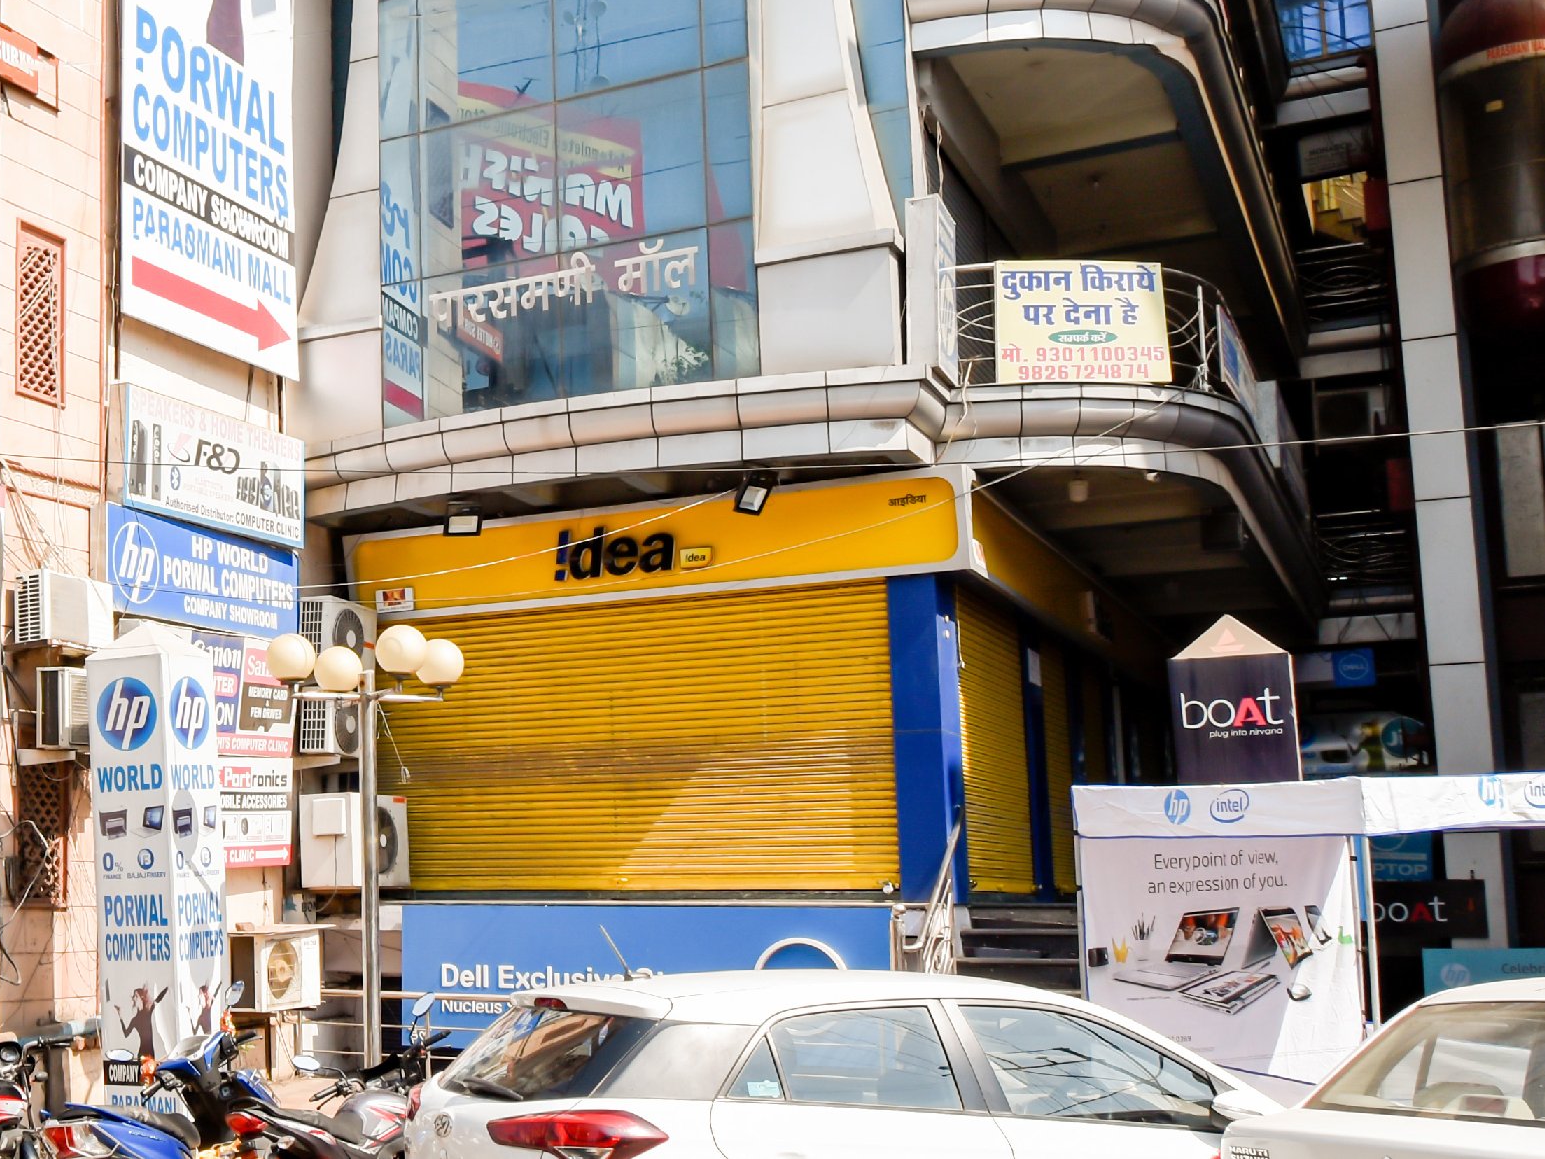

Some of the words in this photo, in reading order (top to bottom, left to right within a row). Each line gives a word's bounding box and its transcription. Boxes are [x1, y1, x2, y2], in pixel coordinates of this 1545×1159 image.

[136, 5, 285, 156] PORWAL
[134, 83, 288, 220] COMPUTERS
[133, 154, 207, 217] COMPANY
[133, 196, 241, 282] PARASMANI
[248, 253, 290, 305] MALL
[615, 239, 698, 294] मॉल
[1001, 271, 1072, 300] दुकान
[1080, 263, 1156, 292] किराये
[1023, 305, 1056, 325] पर
[1063, 298, 1112, 325] देना
[1115, 298, 1139, 325] है
[1036, 347, 1165, 362] 9301100345
[1018, 364, 1149, 380] 9826724874
[131, 394, 195, 429] SPEAKERS
[199, 413, 207, 434] &
[211, 416, 244, 443] HOME
[247, 427, 300, 461] THEATERS
[195, 438, 241, 474] F&D
[888, 494, 927, 507] आइडिया
[166, 496, 199, 514] Authorised
[235, 511, 274, 532] COMPUTER
[276, 522, 299, 539] CLINIC
[119, 522, 156, 602] hp
[191, 535, 213, 561] HP
[217, 542, 269, 575] WORLD
[163, 555, 219, 595] PORWAL
[221, 568, 294, 611] COMPUTERS
[184, 596, 228, 622] COMPANY
[229, 606, 278, 630] SHOWROOM
[105, 679, 151, 750] hp
[176, 678, 206, 750] hp
[1180, 687, 1285, 729] boAt
[232, 738, 267, 752] COMPUTER
[267, 739, 289, 753] CLINIC
[97, 763, 163, 793] WORLD
[171, 764, 215, 790] WORLD
[224, 766, 288, 788] Portronics
[242, 794, 287, 809] ACCESSORIES
[1167, 790, 1188, 826] hp
[1217, 796, 1242, 813] intel
[230, 849, 254, 862] CLINIC
[1230, 850, 1243, 866] of
[1148, 881, 1166, 894] an
[1169, 875, 1239, 896] expression
[1243, 873, 1256, 890] of
[1258, 874, 1287, 891] you.
[104, 894, 168, 927] PORWAL
[177, 891, 222, 927] PORWAL
[105, 933, 170, 961] COMPUTERS
[179, 928, 224, 961] COMPUTERS
[441, 963, 489, 989] Dell
[441, 999, 503, 1015] Nucleus
[109, 1064, 139, 1082] COMPANY
